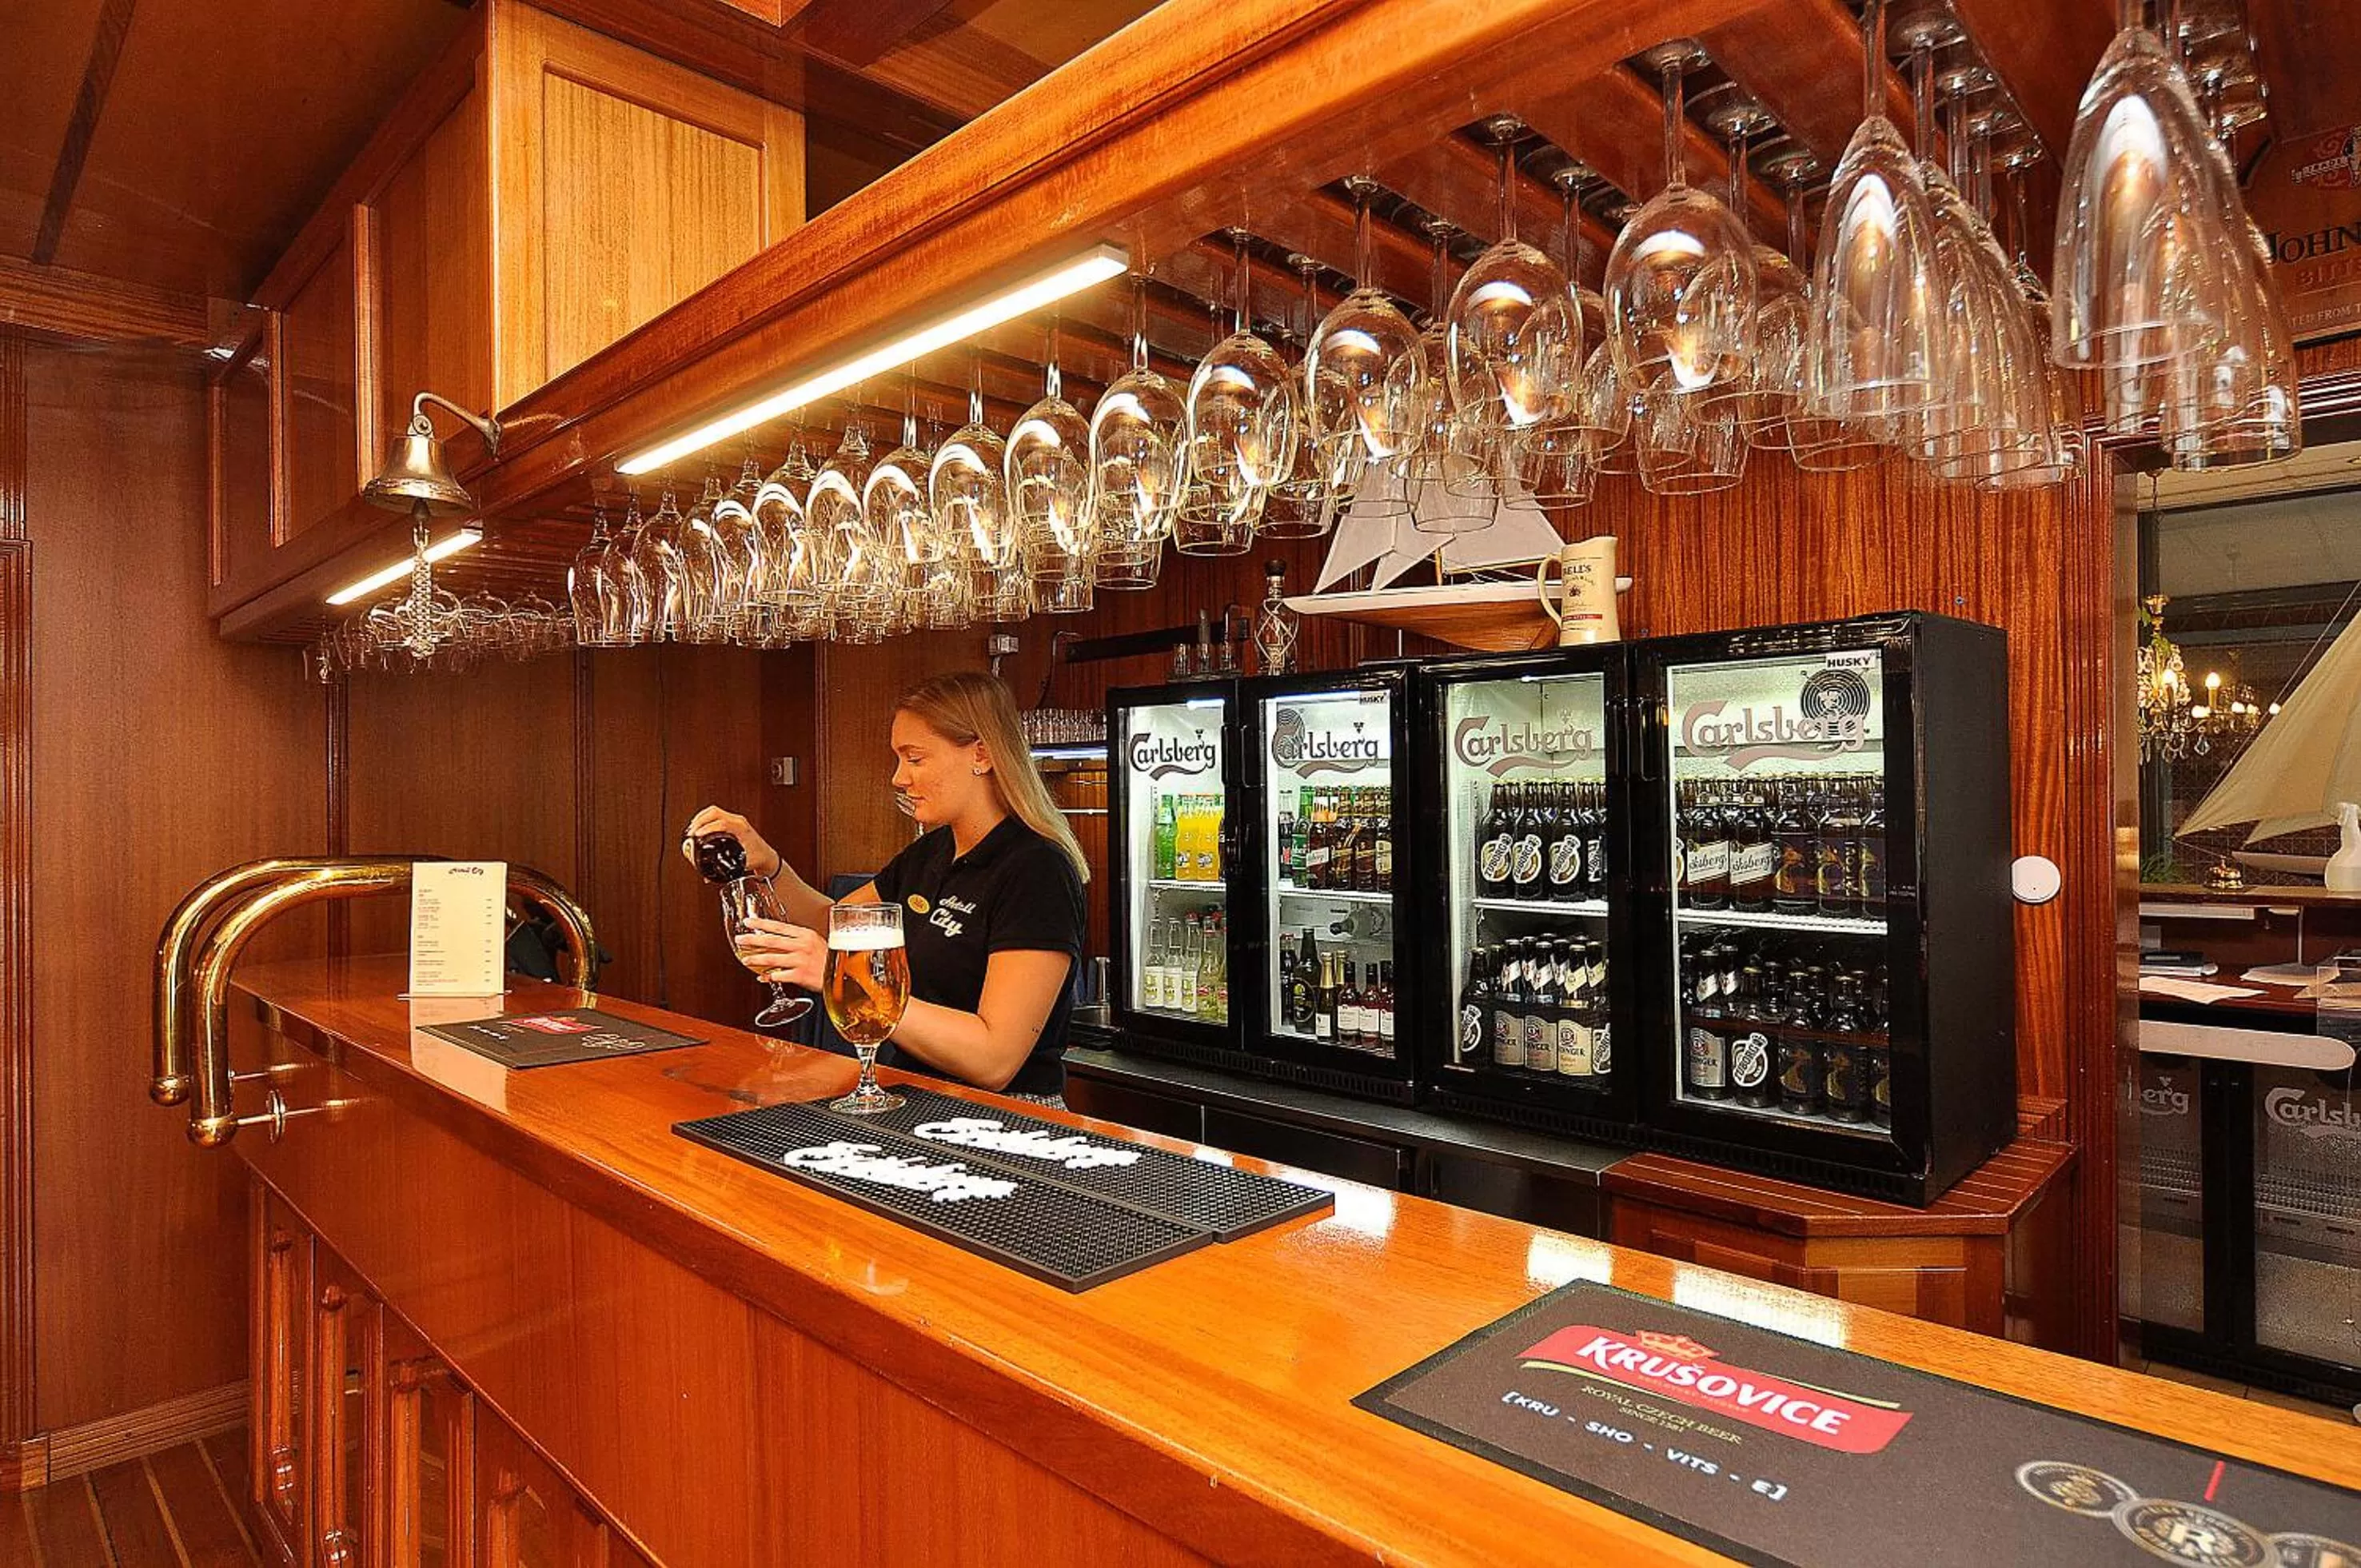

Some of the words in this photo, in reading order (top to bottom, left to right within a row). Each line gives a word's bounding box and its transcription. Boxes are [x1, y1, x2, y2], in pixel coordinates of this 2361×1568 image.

[1827, 657, 1870, 668] HUSKY
[1271, 726, 1379, 770] Carlsberg
[1454, 716, 1593, 768] Carlsberg
[1682, 700, 1865, 759] Carlsberg
[1130, 731, 1216, 774] Carlsberg
[1484, 841, 1509, 878] TUBORG
[929, 908, 963, 937] City
[1733, 1043, 1759, 1081] TUBORG
[1575, 1336, 1851, 1435] KRUŠOVICE
[1581, 1385, 1633, 1408] ROYAL
[1636, 1403, 1696, 1428] CZECH
[1697, 1422, 1743, 1446] BEER
[1618, 1406, 1658, 1425] SINCE
[1585, 1421, 1634, 1443] SHO
[1666, 1447, 1718, 1475] VITS
